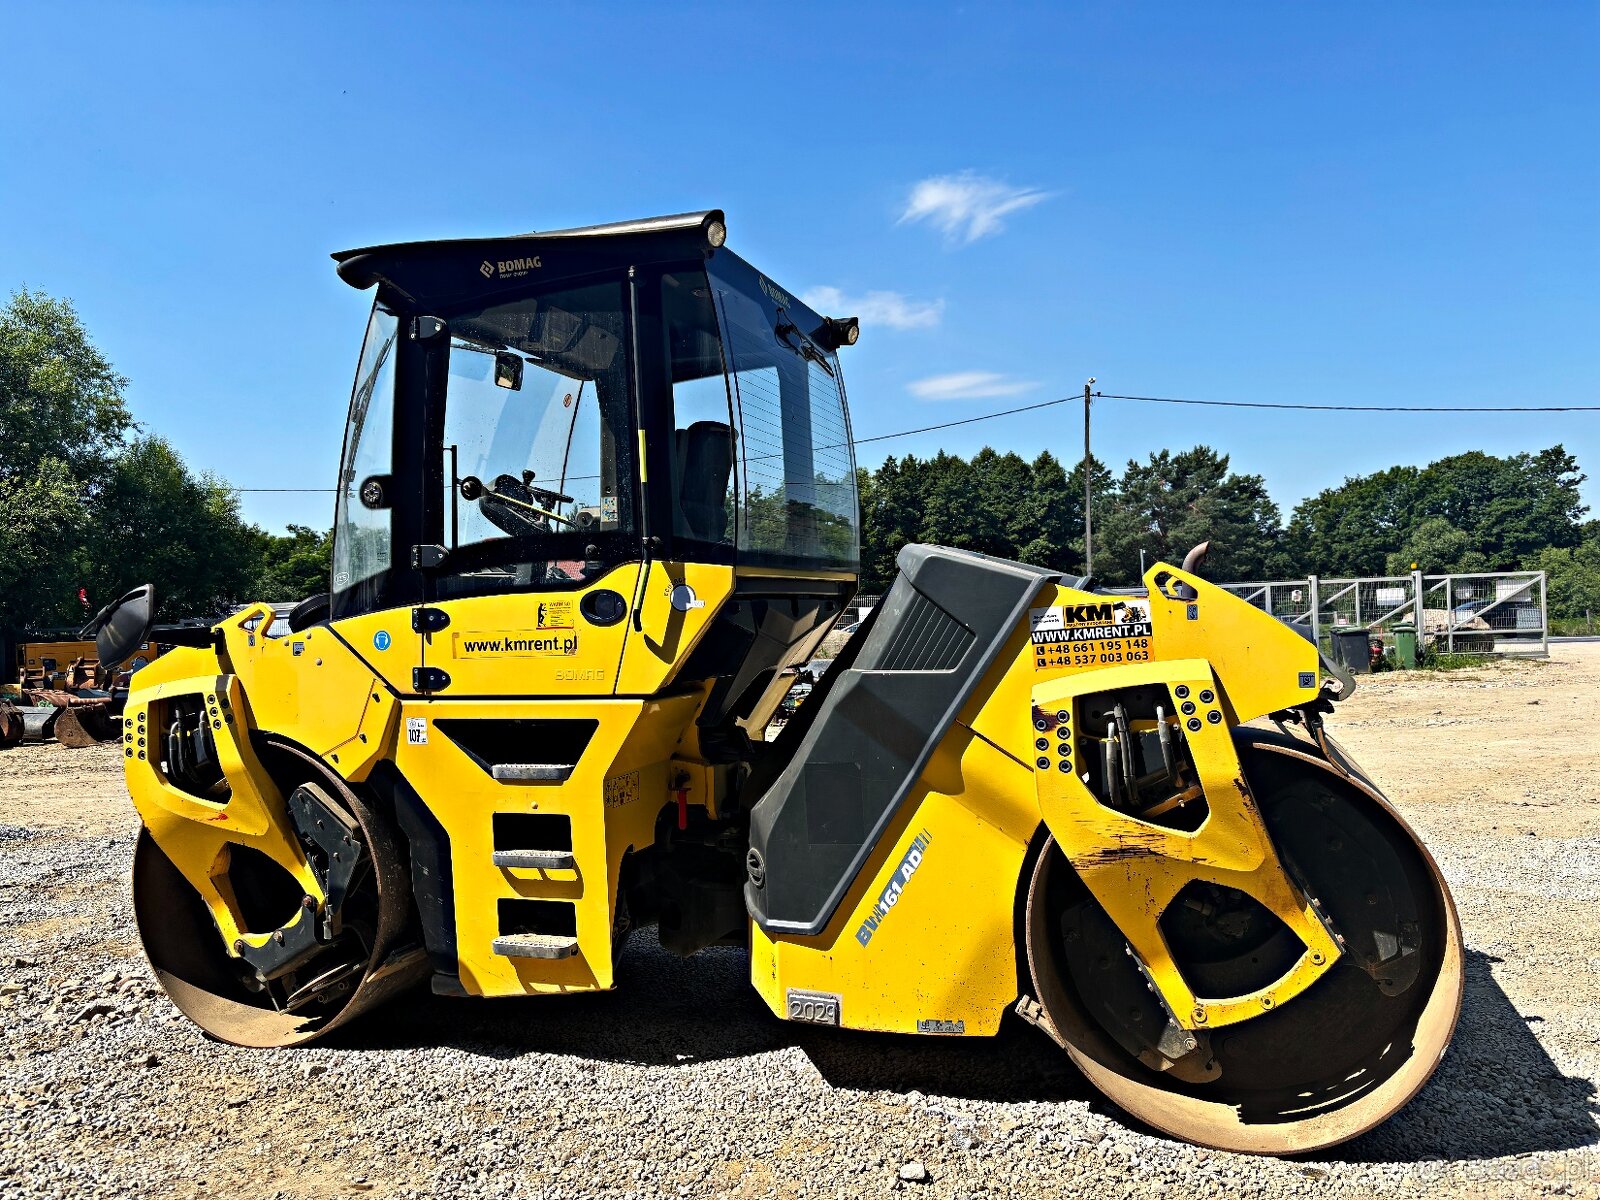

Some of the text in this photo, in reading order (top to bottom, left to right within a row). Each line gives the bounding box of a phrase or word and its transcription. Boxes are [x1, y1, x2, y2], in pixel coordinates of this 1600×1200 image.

[497, 256, 542, 273] BOMAG
[1066, 604, 1113, 623] KM
[1032, 624, 1151, 643] WWW.KMRENT.PL
[464, 635, 577, 654] www.kmrent.pl
[1048, 639, 1148, 654] +48 661 195 148
[1049, 651, 1148, 666] +48 537 003 063
[555, 669, 605, 680] BOMAG
[409, 729, 421, 742] 107
